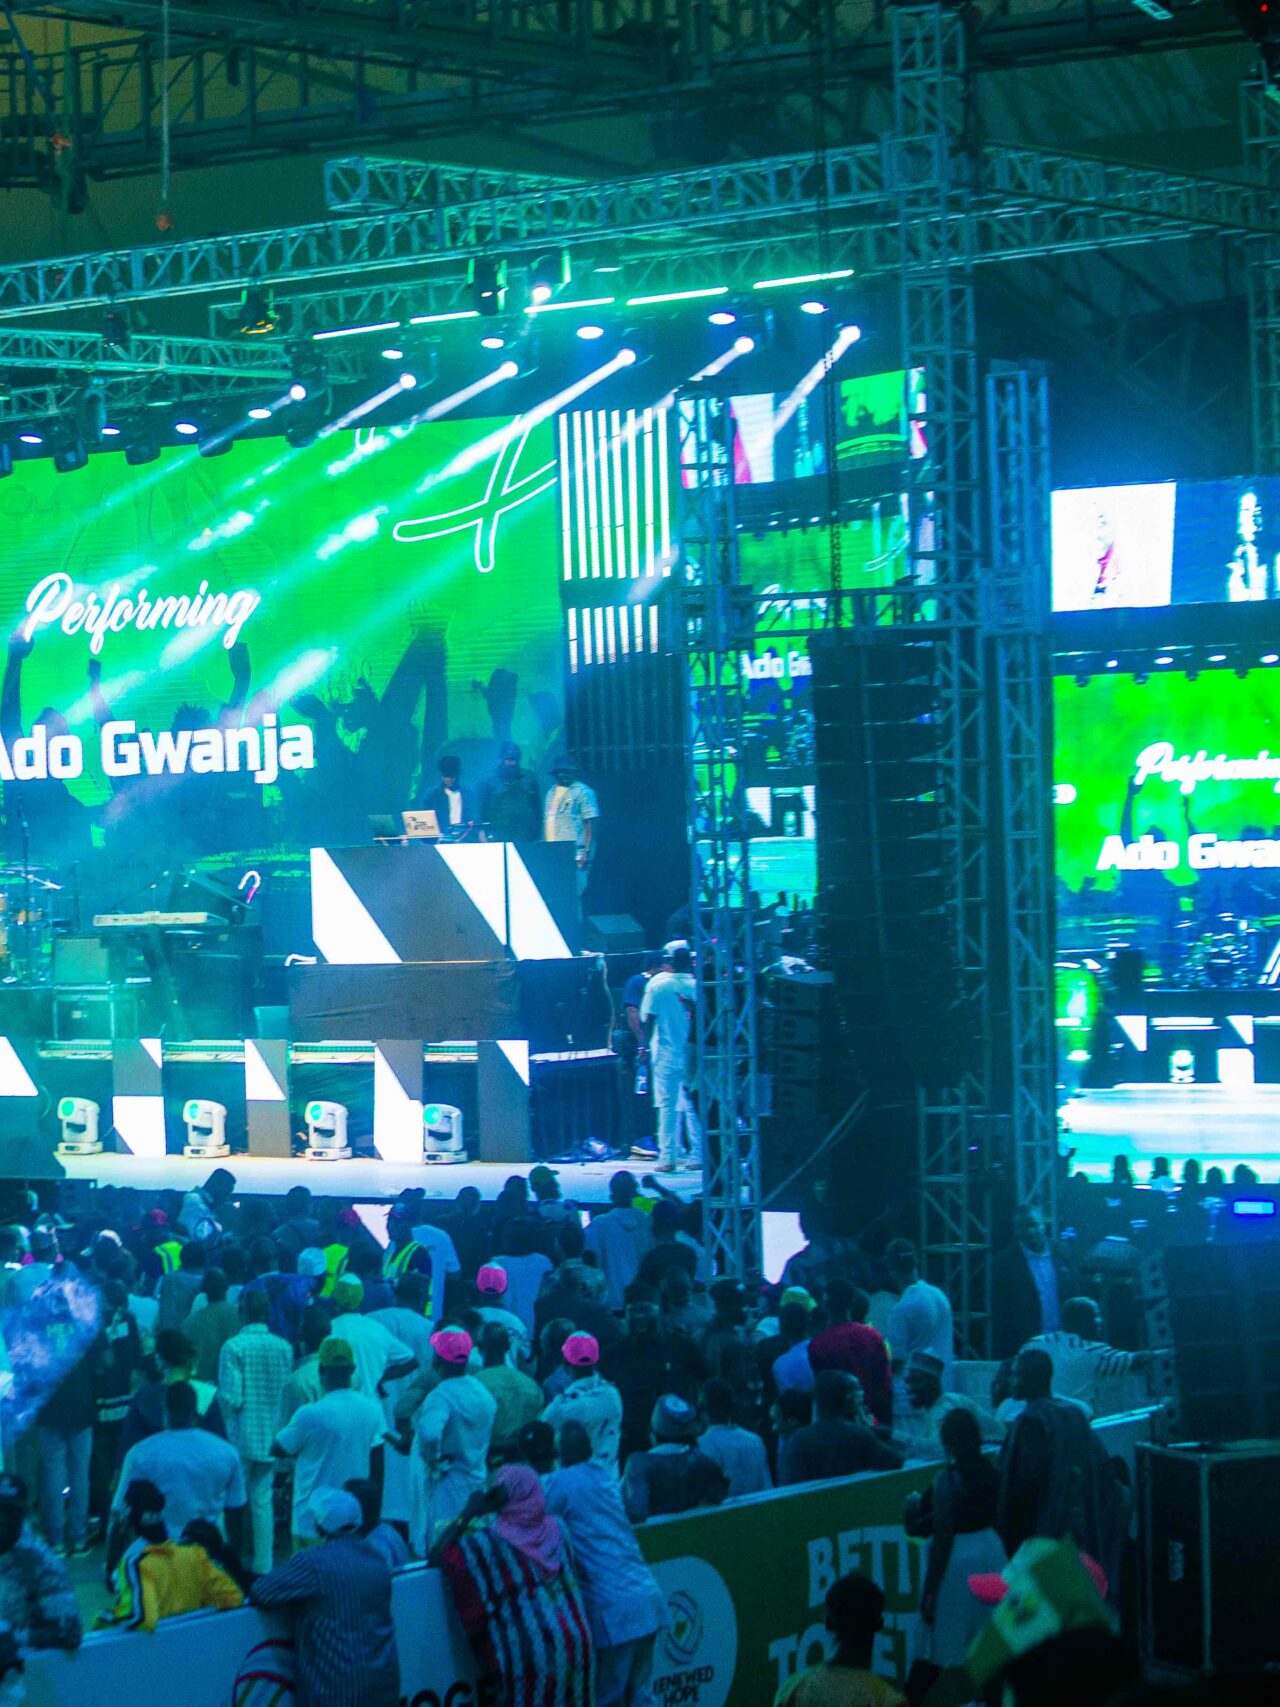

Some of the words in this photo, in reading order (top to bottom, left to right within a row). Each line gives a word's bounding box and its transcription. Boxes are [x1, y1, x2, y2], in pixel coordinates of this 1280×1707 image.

[23, 572, 261, 655] Performing
[100, 712, 315, 784] Gwanja
[1095, 834, 1180, 871] Ado
